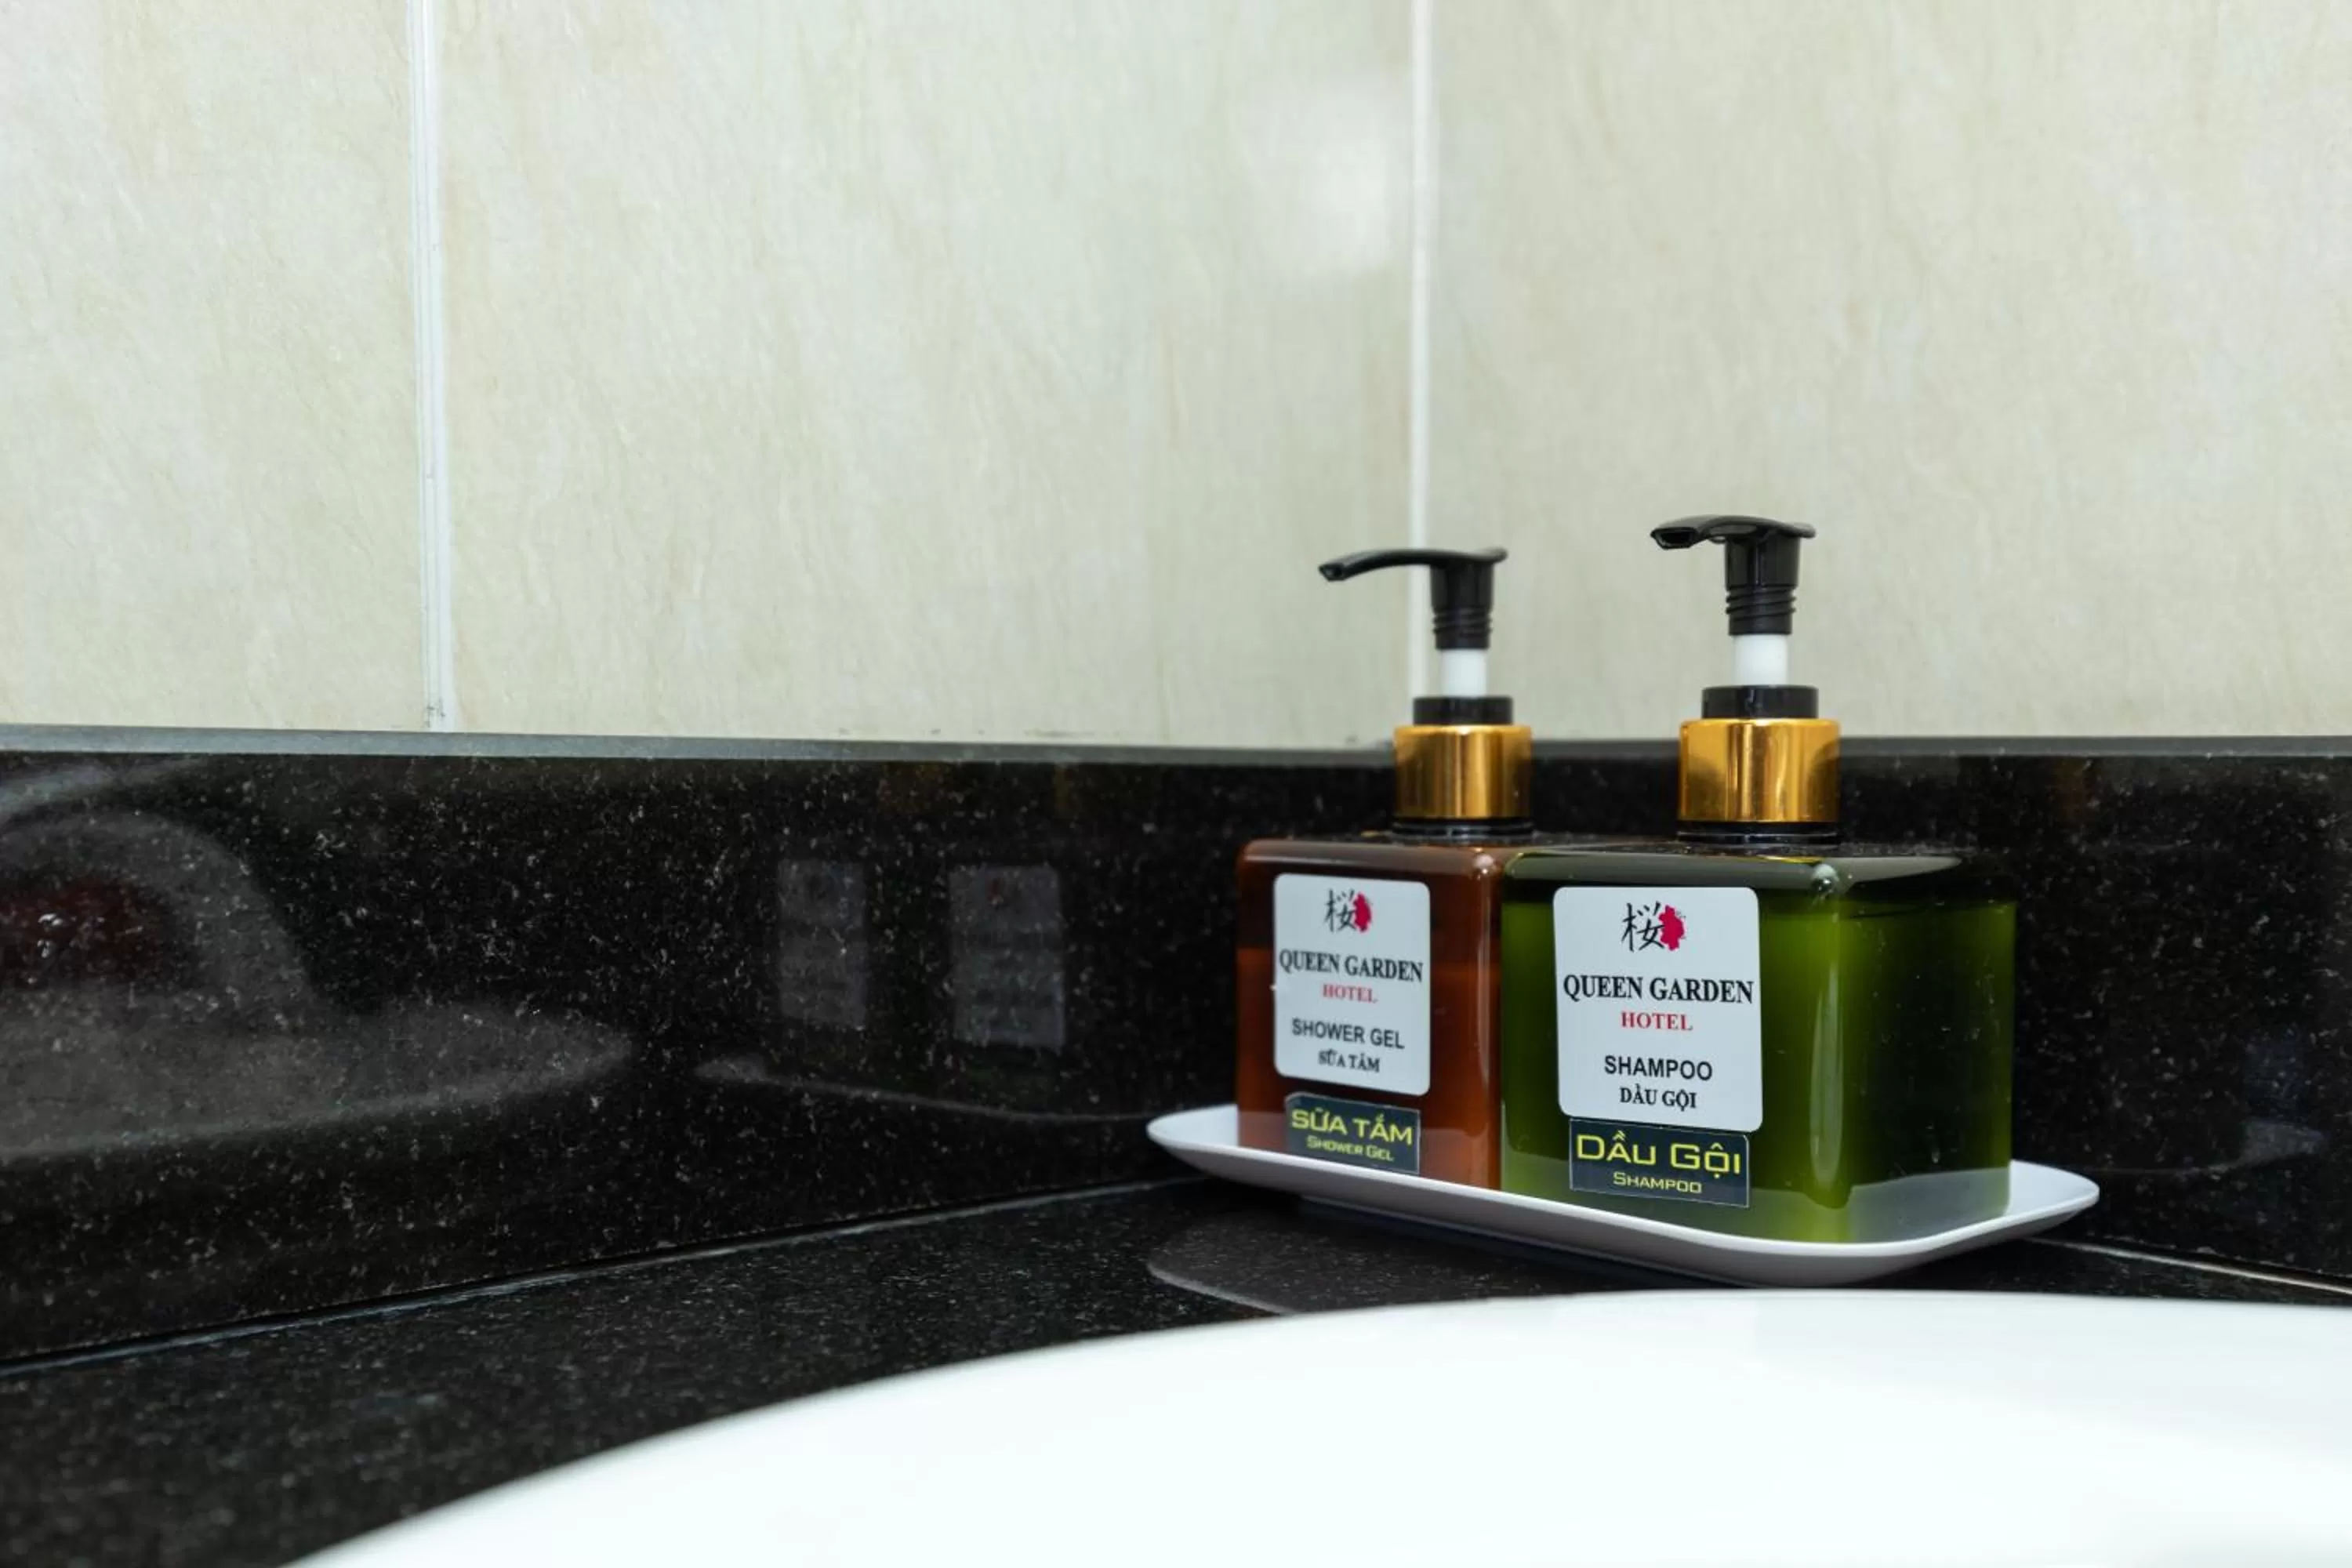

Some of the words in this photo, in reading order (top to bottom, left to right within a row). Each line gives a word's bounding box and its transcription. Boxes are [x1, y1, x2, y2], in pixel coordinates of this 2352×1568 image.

[1279, 949, 1339, 974] QUEEN
[1345, 955, 1423, 982] GARDEN
[1323, 984, 1377, 1004] HOTEL
[1563, 975, 1643, 1002] QUEEN
[1649, 978, 1755, 1004] GARDEN
[1292, 1018, 1365, 1044] SHOWER
[1370, 1028, 1405, 1049] GEL
[1621, 1011, 1693, 1031] HOTEL
[1605, 1055, 1712, 1081] SHAMPOO
[1670, 1142, 1741, 1179] GỘI
